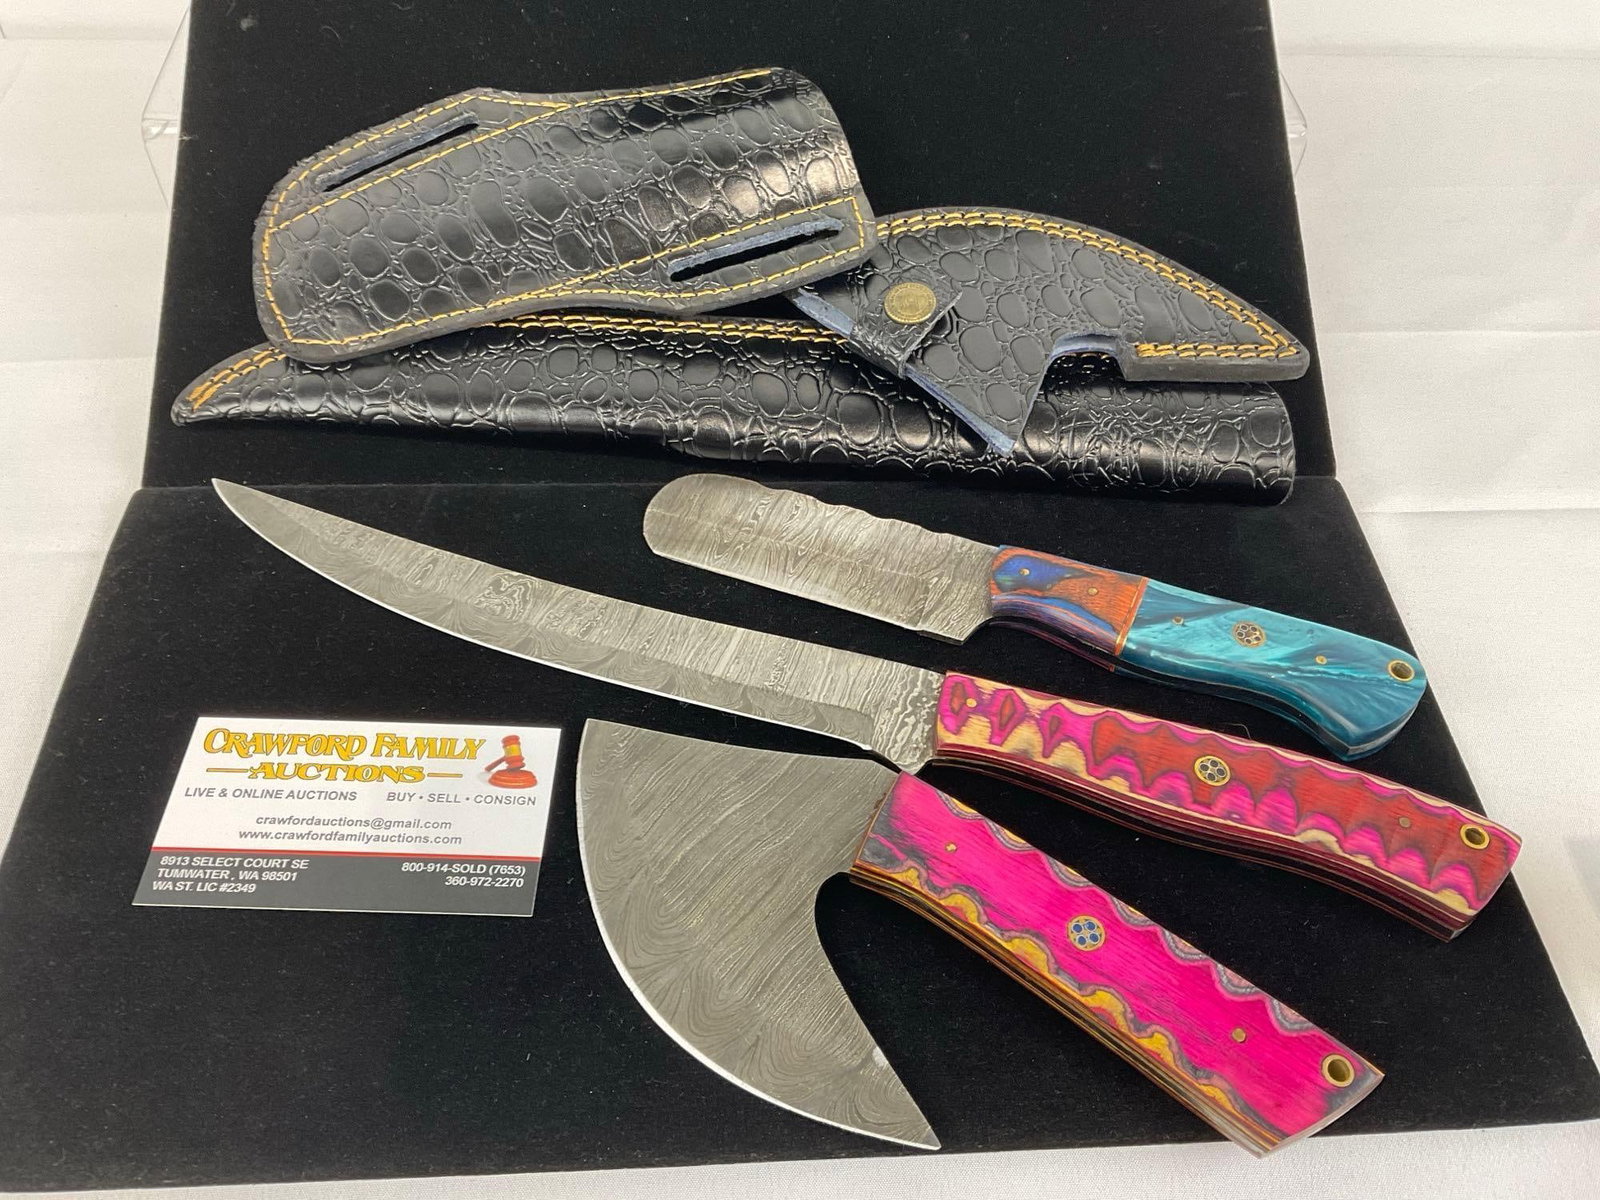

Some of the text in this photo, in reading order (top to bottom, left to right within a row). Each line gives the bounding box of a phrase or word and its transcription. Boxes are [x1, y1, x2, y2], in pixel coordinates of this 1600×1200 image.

[204, 728, 486, 761] CRAWFORD FAMILY
[248, 762, 425, 784] AUCTIONS
[184, 787, 358, 801] LIVE & ONLINE AUCTIONS
[386, 792, 537, 806] BUY SELL CONSIGN
[255, 815, 452, 830] crawfordauctions@gmail.com
[238, 830, 462, 845] www.crawfordfamilyauctions.com
[160, 856, 310, 869] 8913 SELECT COURT SE
[401, 862, 526, 876] 800-914-SOLD (7653)
[157, 868, 230, 880] TUMWATER
[238, 870, 259, 880] WA
[261, 871, 298, 881] 98501
[152, 881, 257, 893] WA ST. LIC #2349
[445, 876, 524, 888] 360-972-2270
